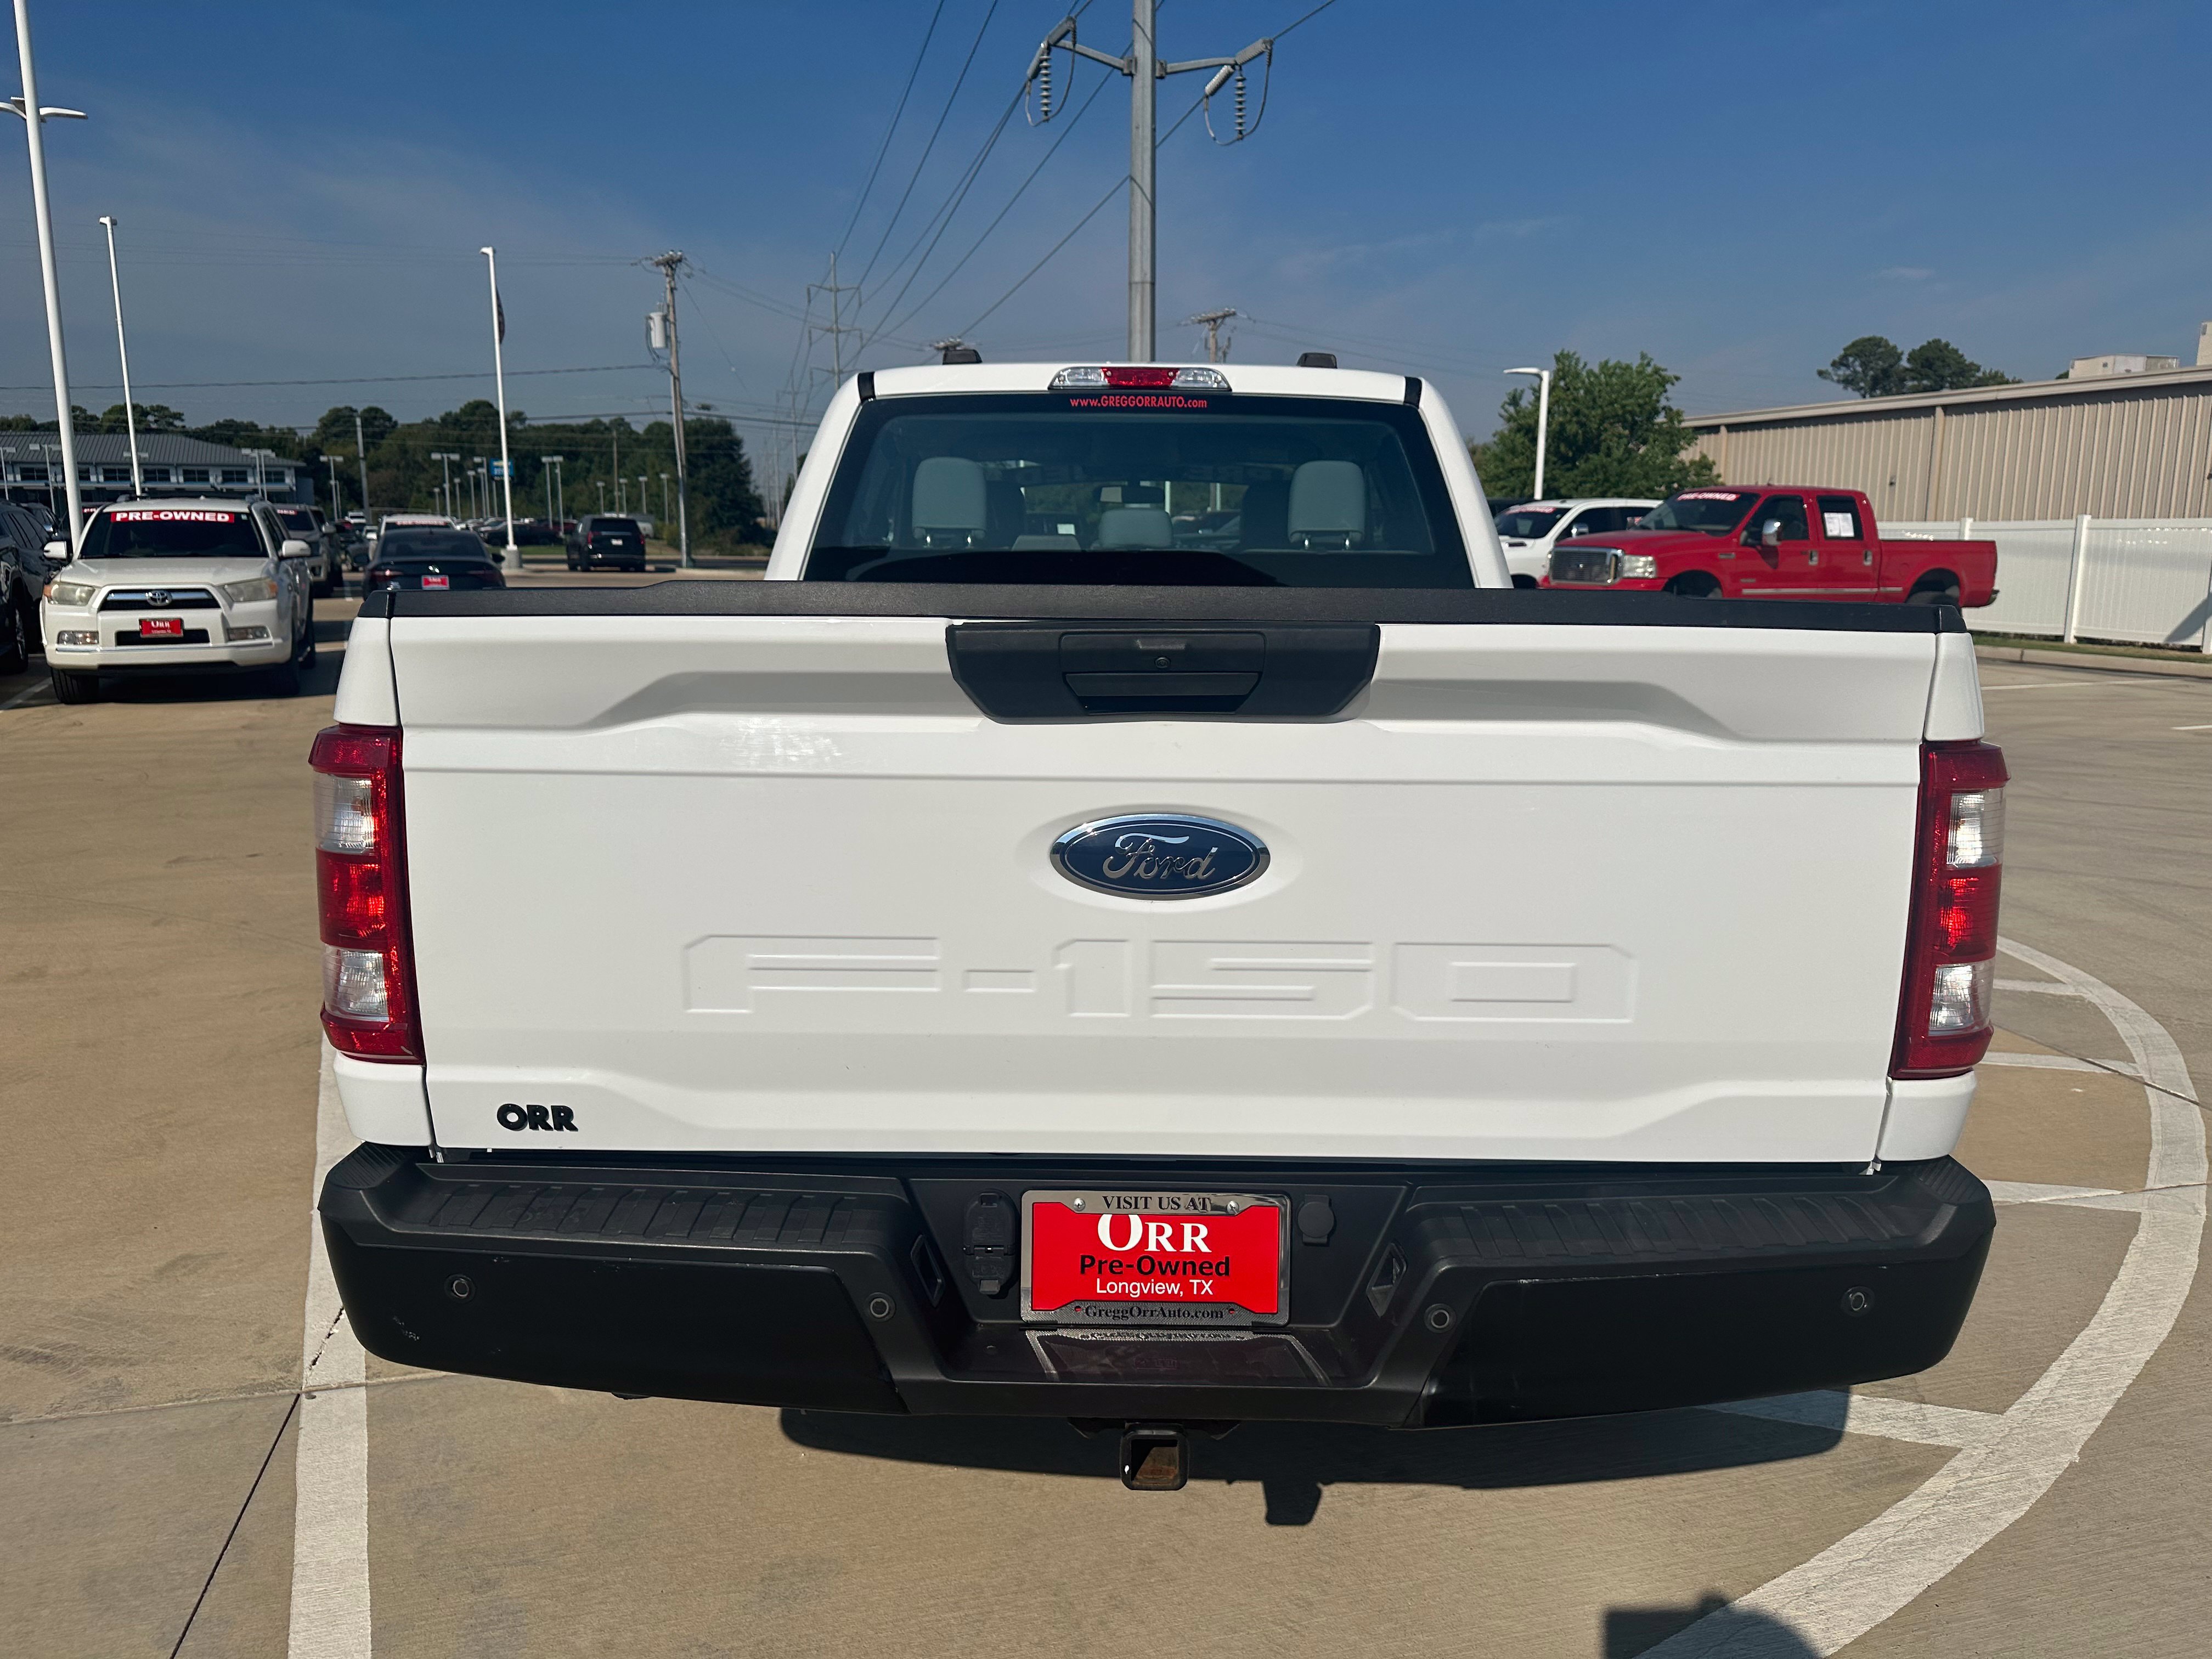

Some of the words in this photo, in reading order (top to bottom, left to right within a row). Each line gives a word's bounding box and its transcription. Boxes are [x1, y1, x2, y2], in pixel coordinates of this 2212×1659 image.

[1070, 395, 1207, 408] www.GREGGORRAUTO.com
[116, 511, 230, 522] PRE-OWNED
[1103, 833, 1218, 879] Ford
[684, 934, 1637, 1023] F-150
[496, 1103, 579, 1132] ORR
[1102, 1195, 1152, 1210] VISIT
[1158, 1197, 1181, 1210] US
[1186, 1197, 1210, 1211] AT
[1080, 1254, 1231, 1276] Pre-Owned
[1096, 1278, 1183, 1298] Longview,
[1189, 1279, 1214, 1295] TX
[1085, 1305, 1224, 1321] GreggOrrAuto.com
